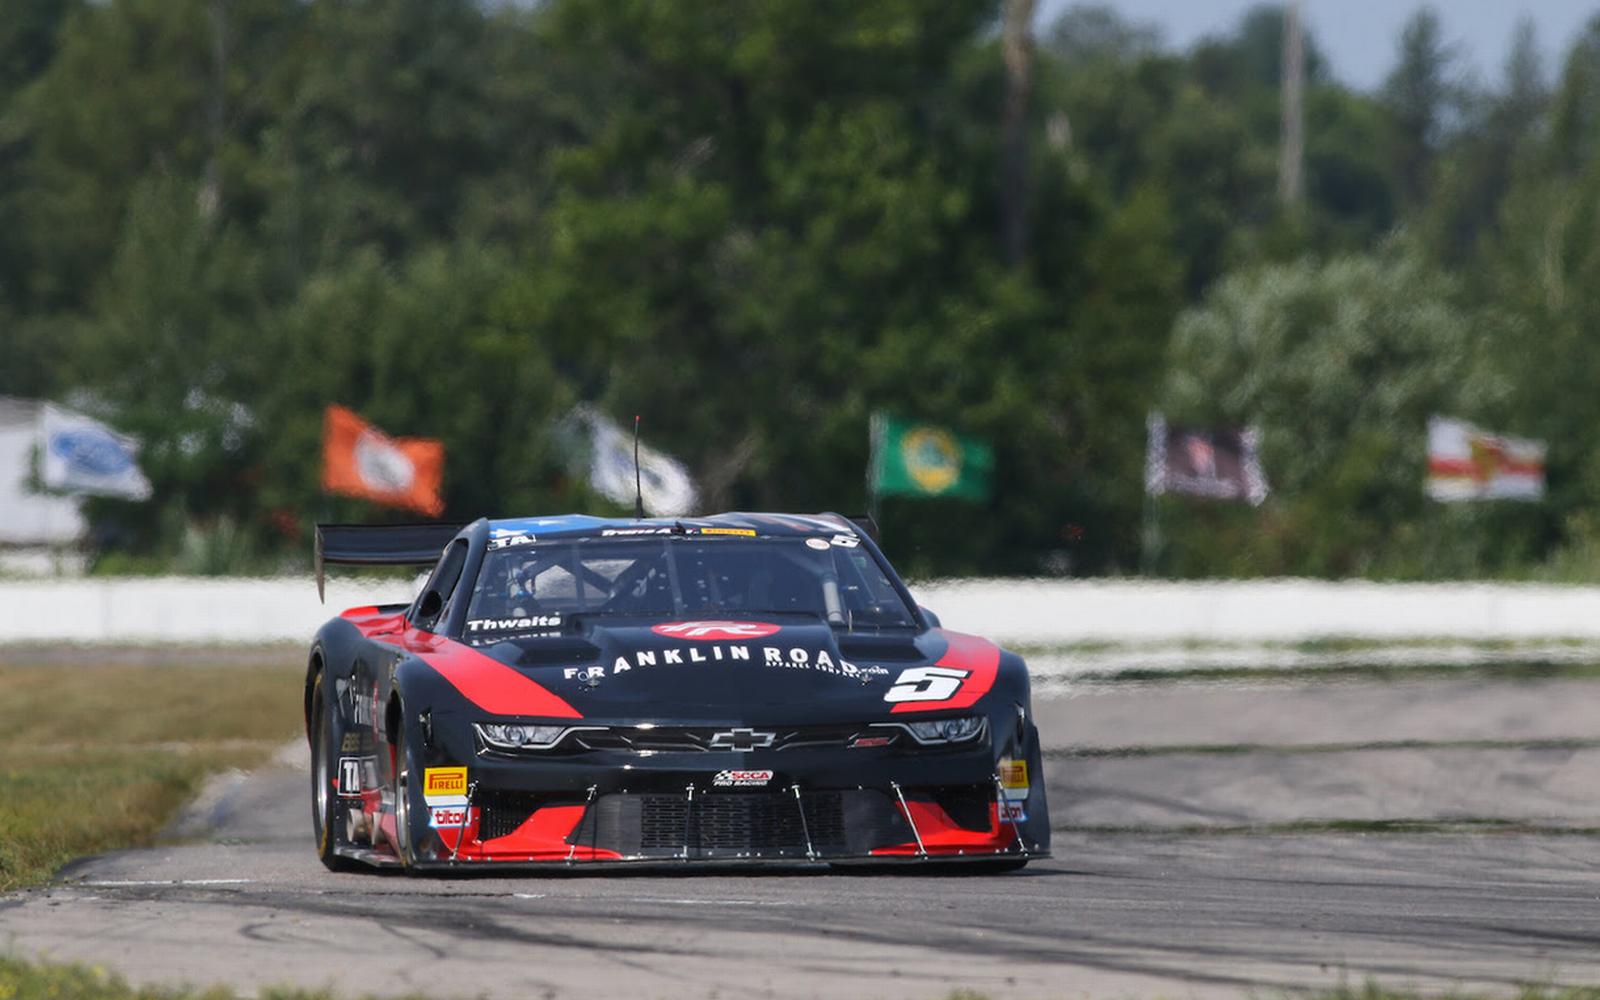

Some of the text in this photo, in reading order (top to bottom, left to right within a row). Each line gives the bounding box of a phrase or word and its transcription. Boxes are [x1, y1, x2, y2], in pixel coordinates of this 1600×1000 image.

[467, 615, 561, 631] Thwaits
[563, 645, 750, 679] FRANKLIN
[763, 646, 858, 674] ROAD
[883, 666, 970, 703] 5
[429, 772, 464, 790] PIRELLI
[731, 770, 769, 781] SCCA
